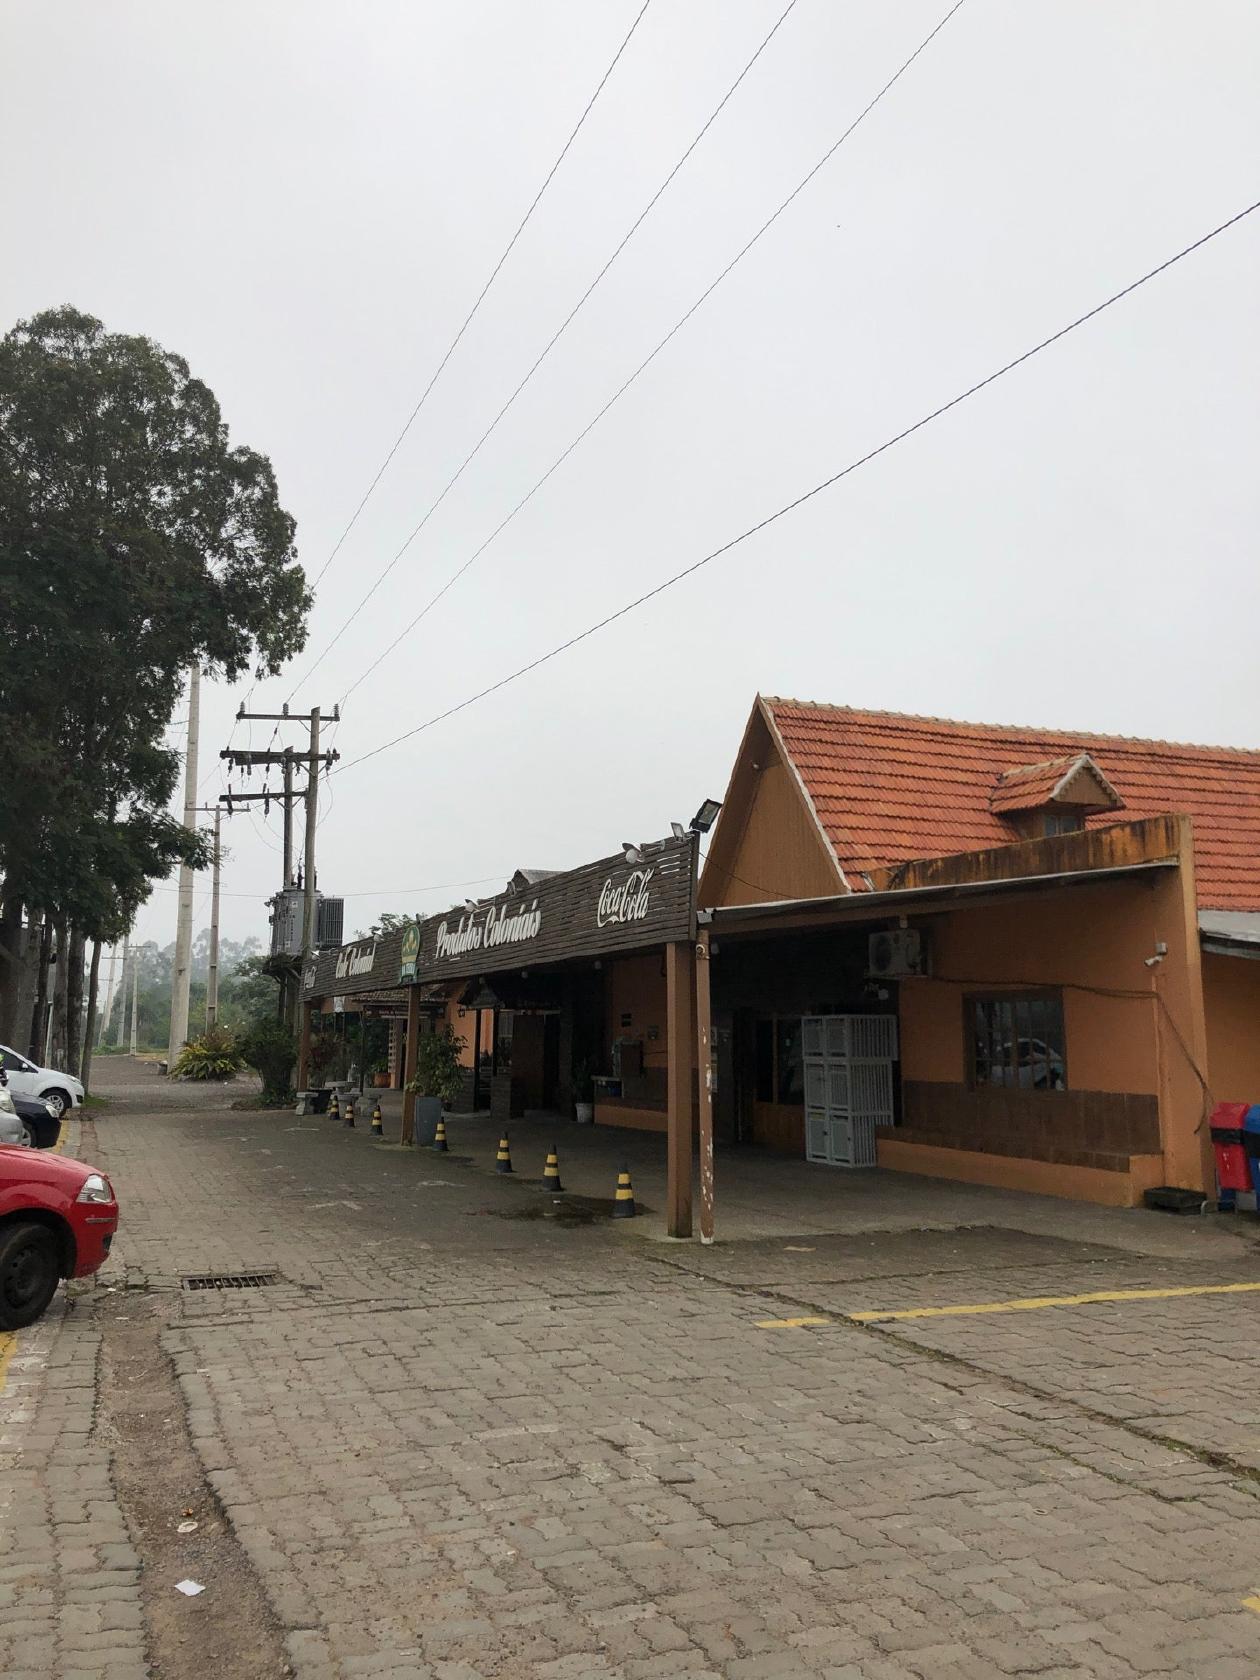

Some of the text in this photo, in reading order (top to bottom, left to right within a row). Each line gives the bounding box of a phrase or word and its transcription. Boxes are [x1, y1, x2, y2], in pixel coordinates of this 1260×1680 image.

[597, 868, 655, 928] Coca-Cola
[435, 898, 542, 959] Produtos Coloniais
